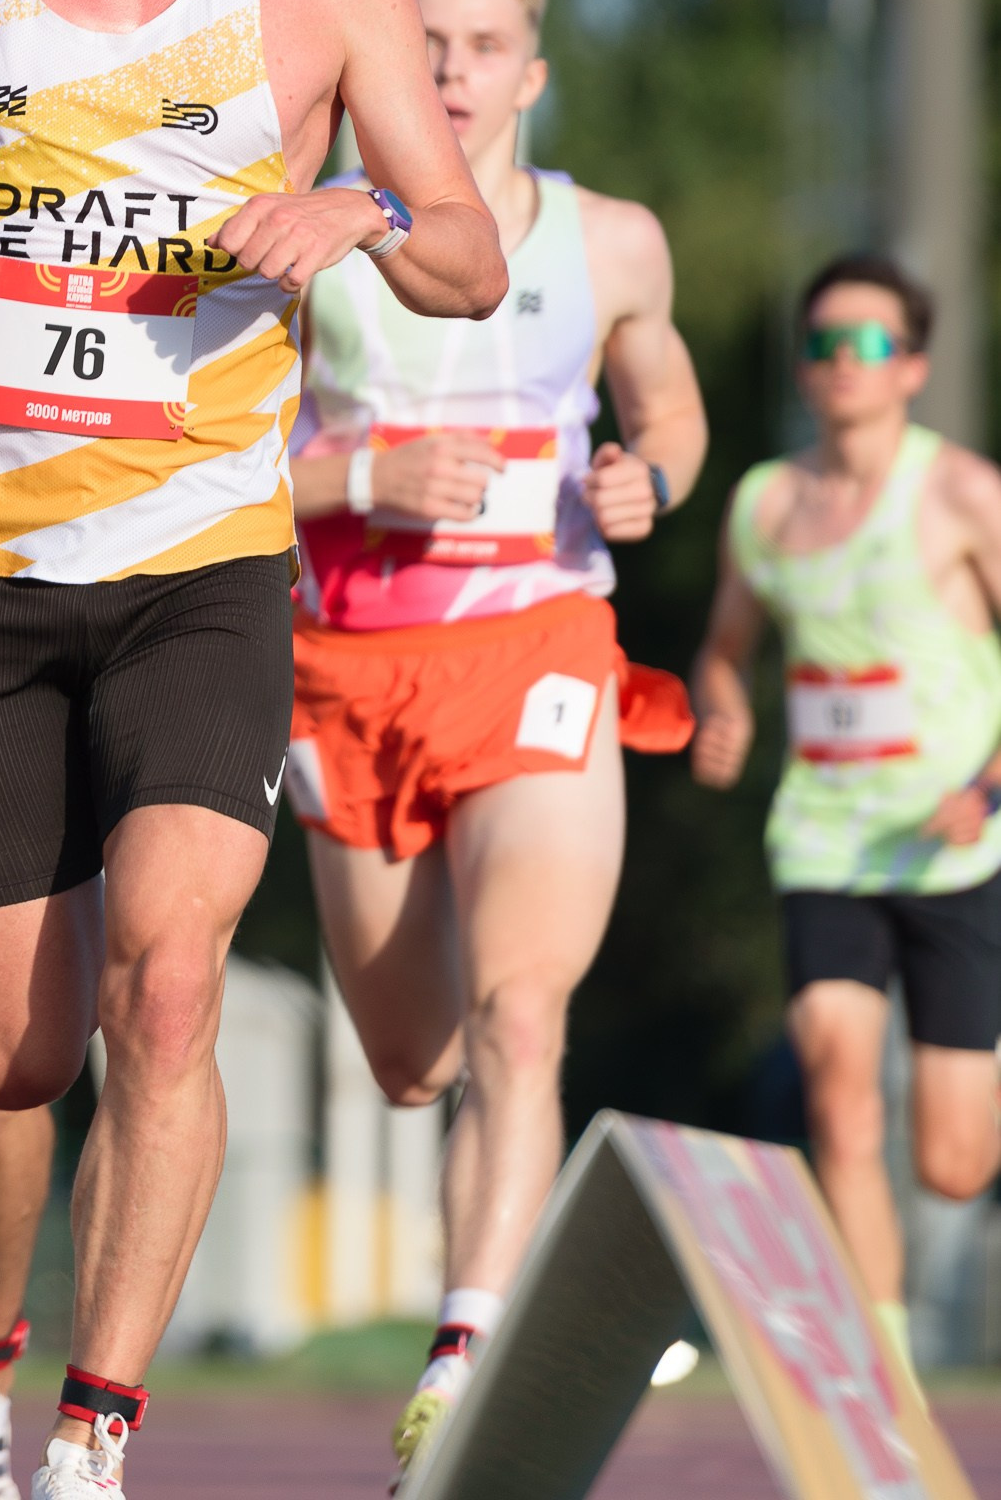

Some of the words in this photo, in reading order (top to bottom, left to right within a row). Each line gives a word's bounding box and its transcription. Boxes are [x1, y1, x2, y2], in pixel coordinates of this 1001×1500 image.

[61, 229, 238, 273] HARD
[43, 323, 106, 380] 76
[26, 402, 59, 420] 3000
[61, 408, 112, 427] метров
